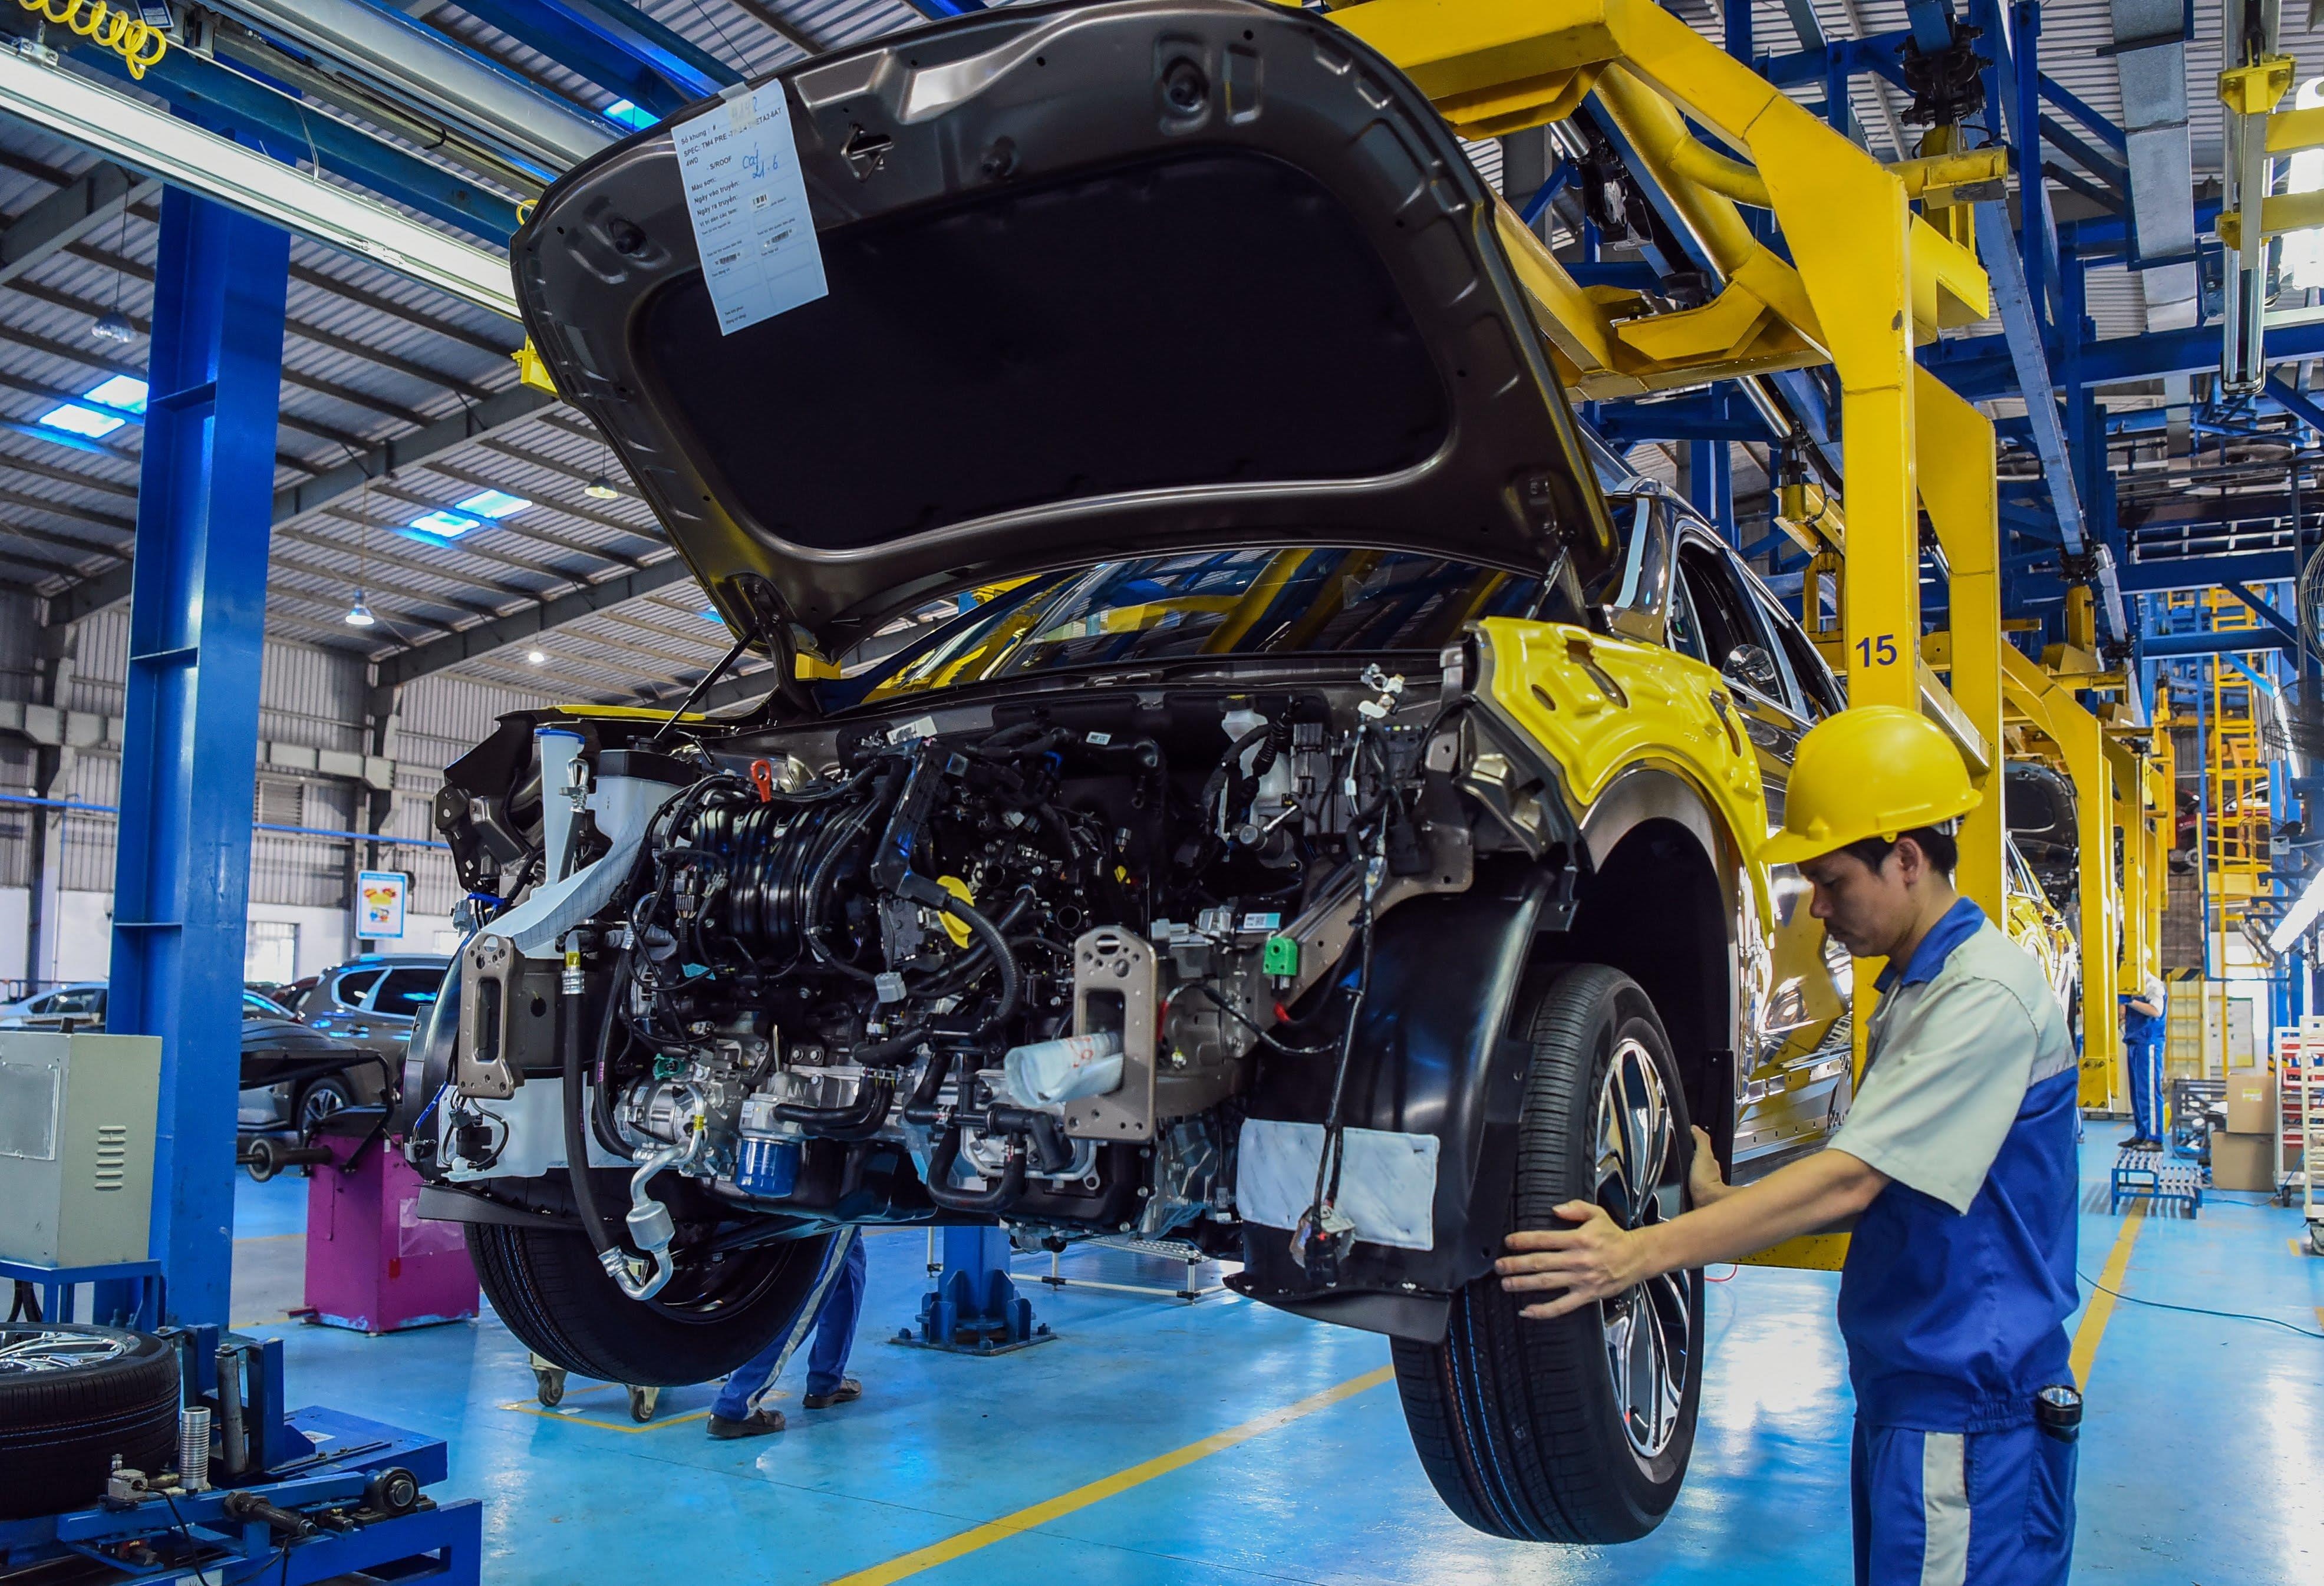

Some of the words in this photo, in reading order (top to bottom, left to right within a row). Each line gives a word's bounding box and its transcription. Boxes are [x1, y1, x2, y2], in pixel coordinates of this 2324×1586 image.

[701, 139, 714, 149] TM4
[715, 134, 727, 143] PRE
[686, 157, 698, 166] 4WD
[710, 156, 731, 170] S/ROOF
[1856, 634, 1897, 668] 15
